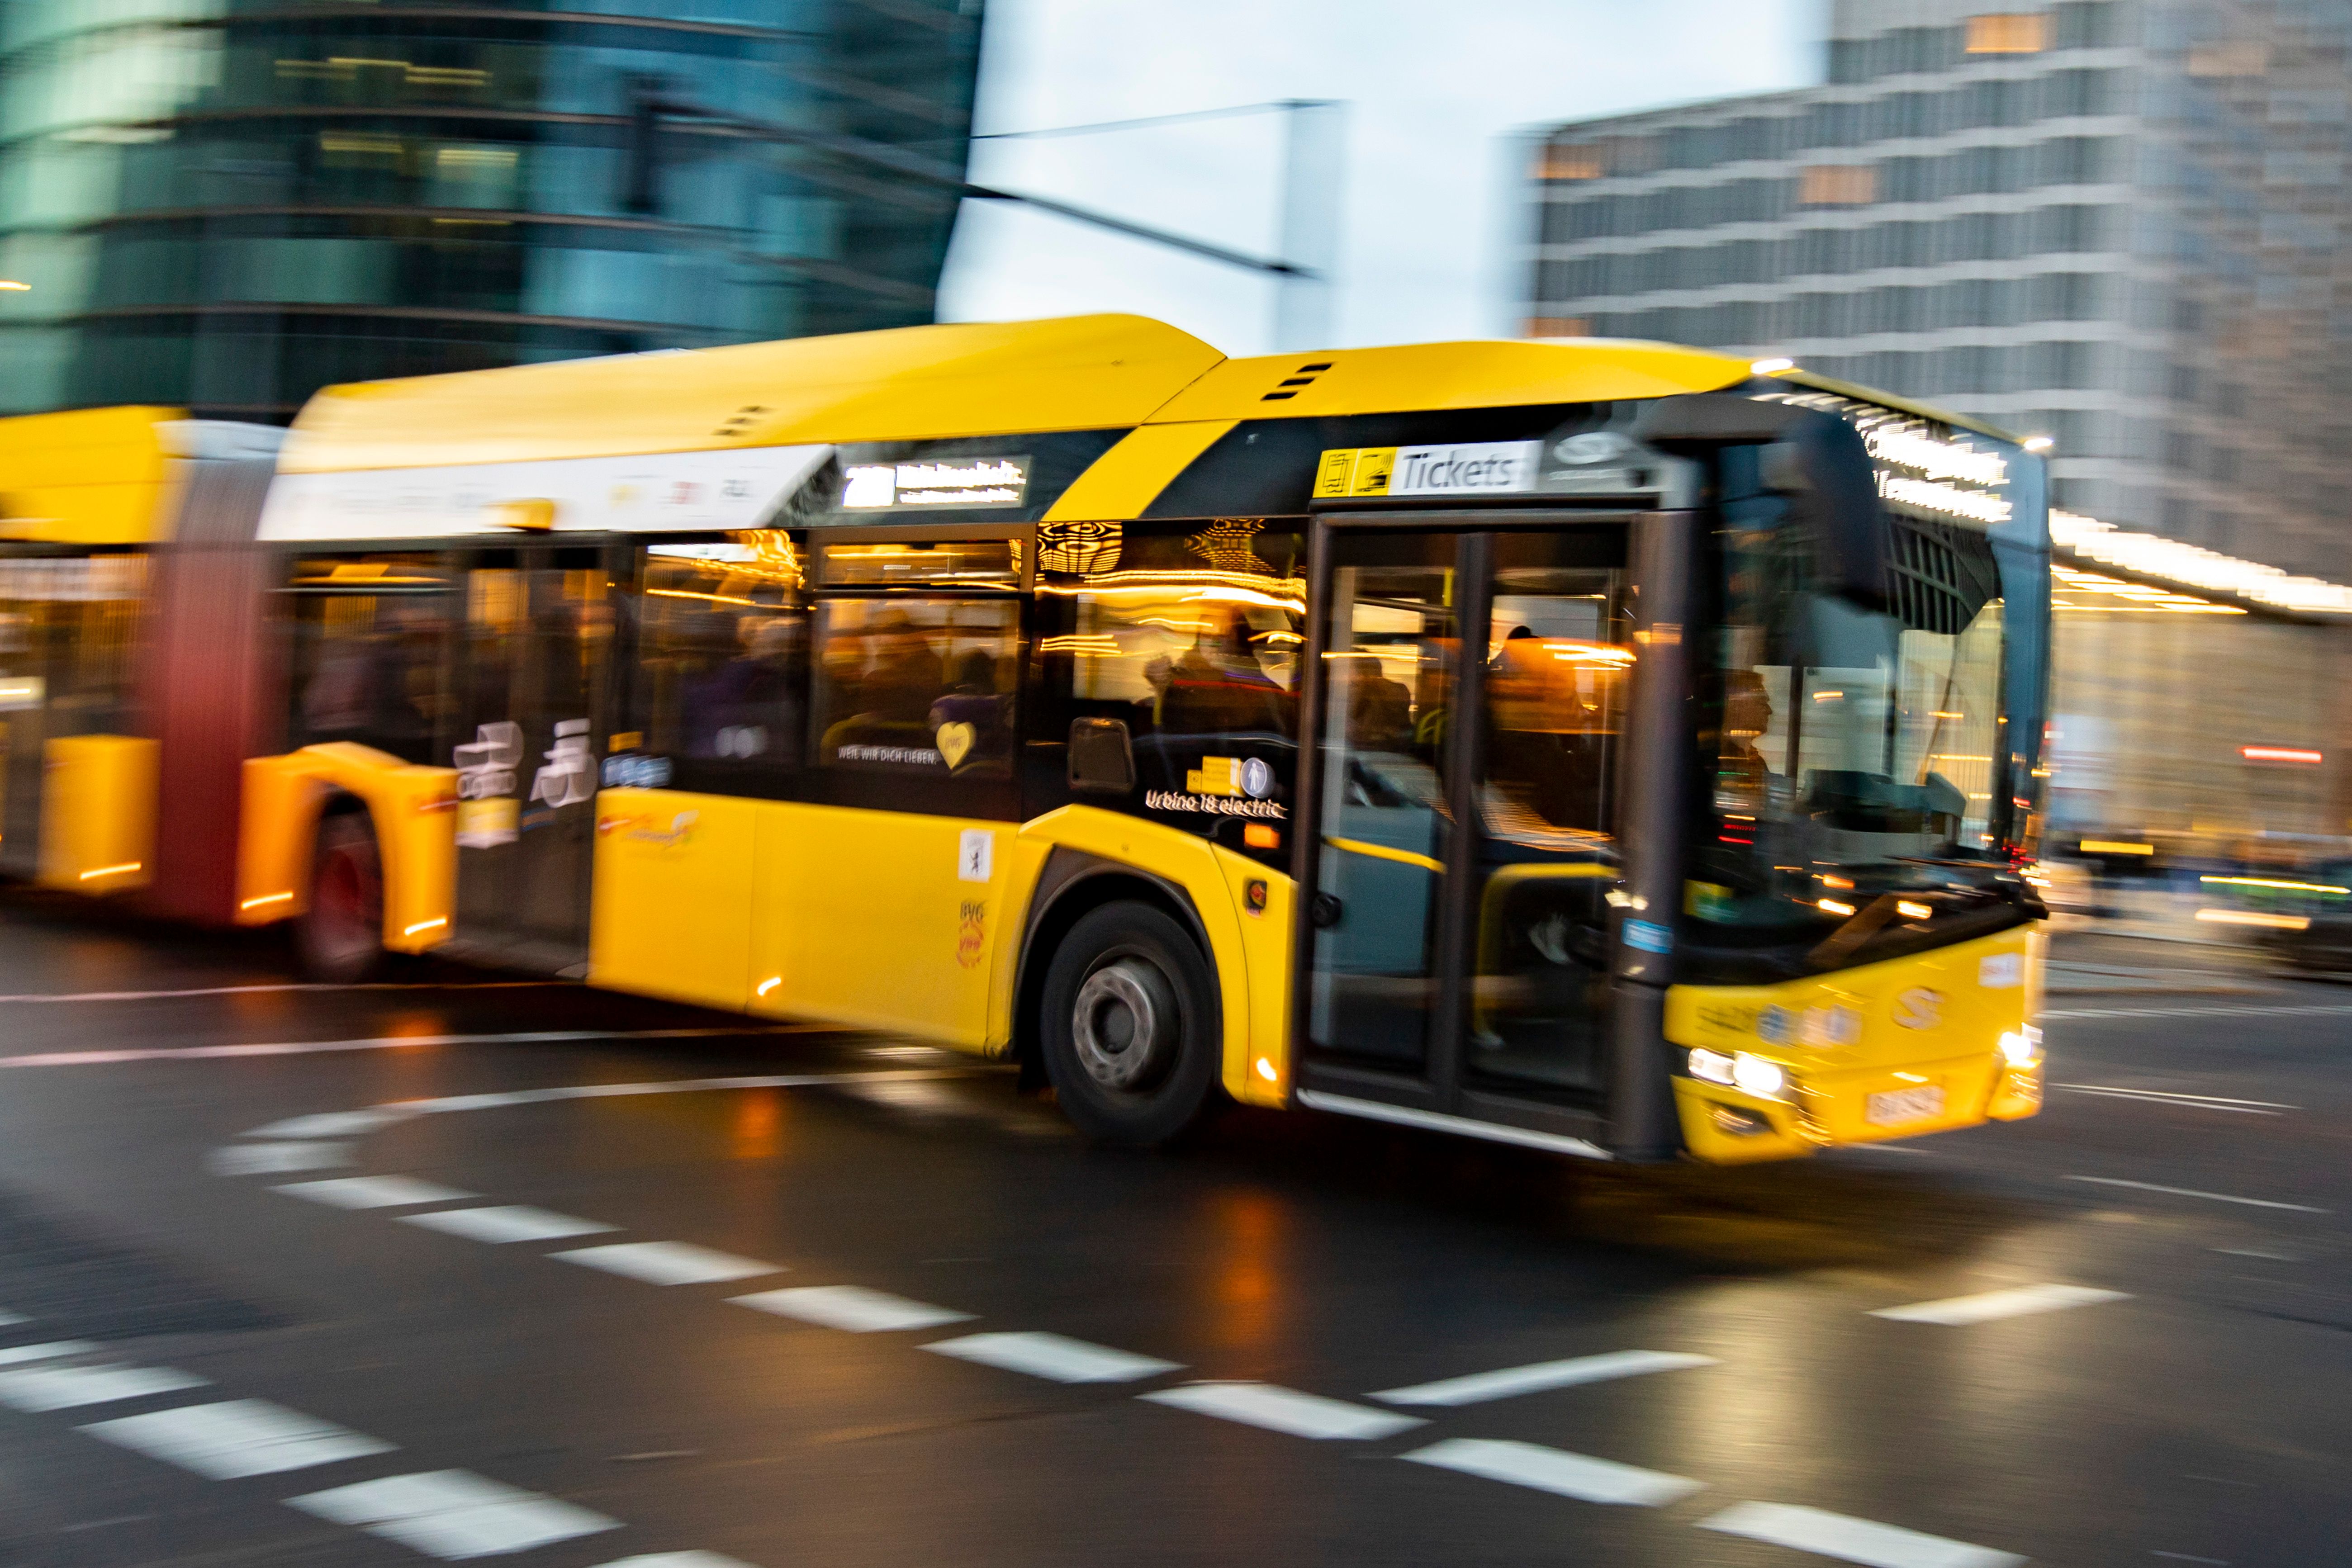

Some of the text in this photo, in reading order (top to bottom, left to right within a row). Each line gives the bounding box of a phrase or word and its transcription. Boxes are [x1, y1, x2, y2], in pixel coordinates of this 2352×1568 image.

[1401, 450, 1513, 490] Tickets
[945, 737, 962, 749] BVG
[838, 747, 858, 759] WEIL
[861, 748, 878, 761] WIR
[881, 748, 902, 762] DICH
[1145, 789, 1288, 820] Urbino 18 electric
[960, 901, 984, 923] BVG
